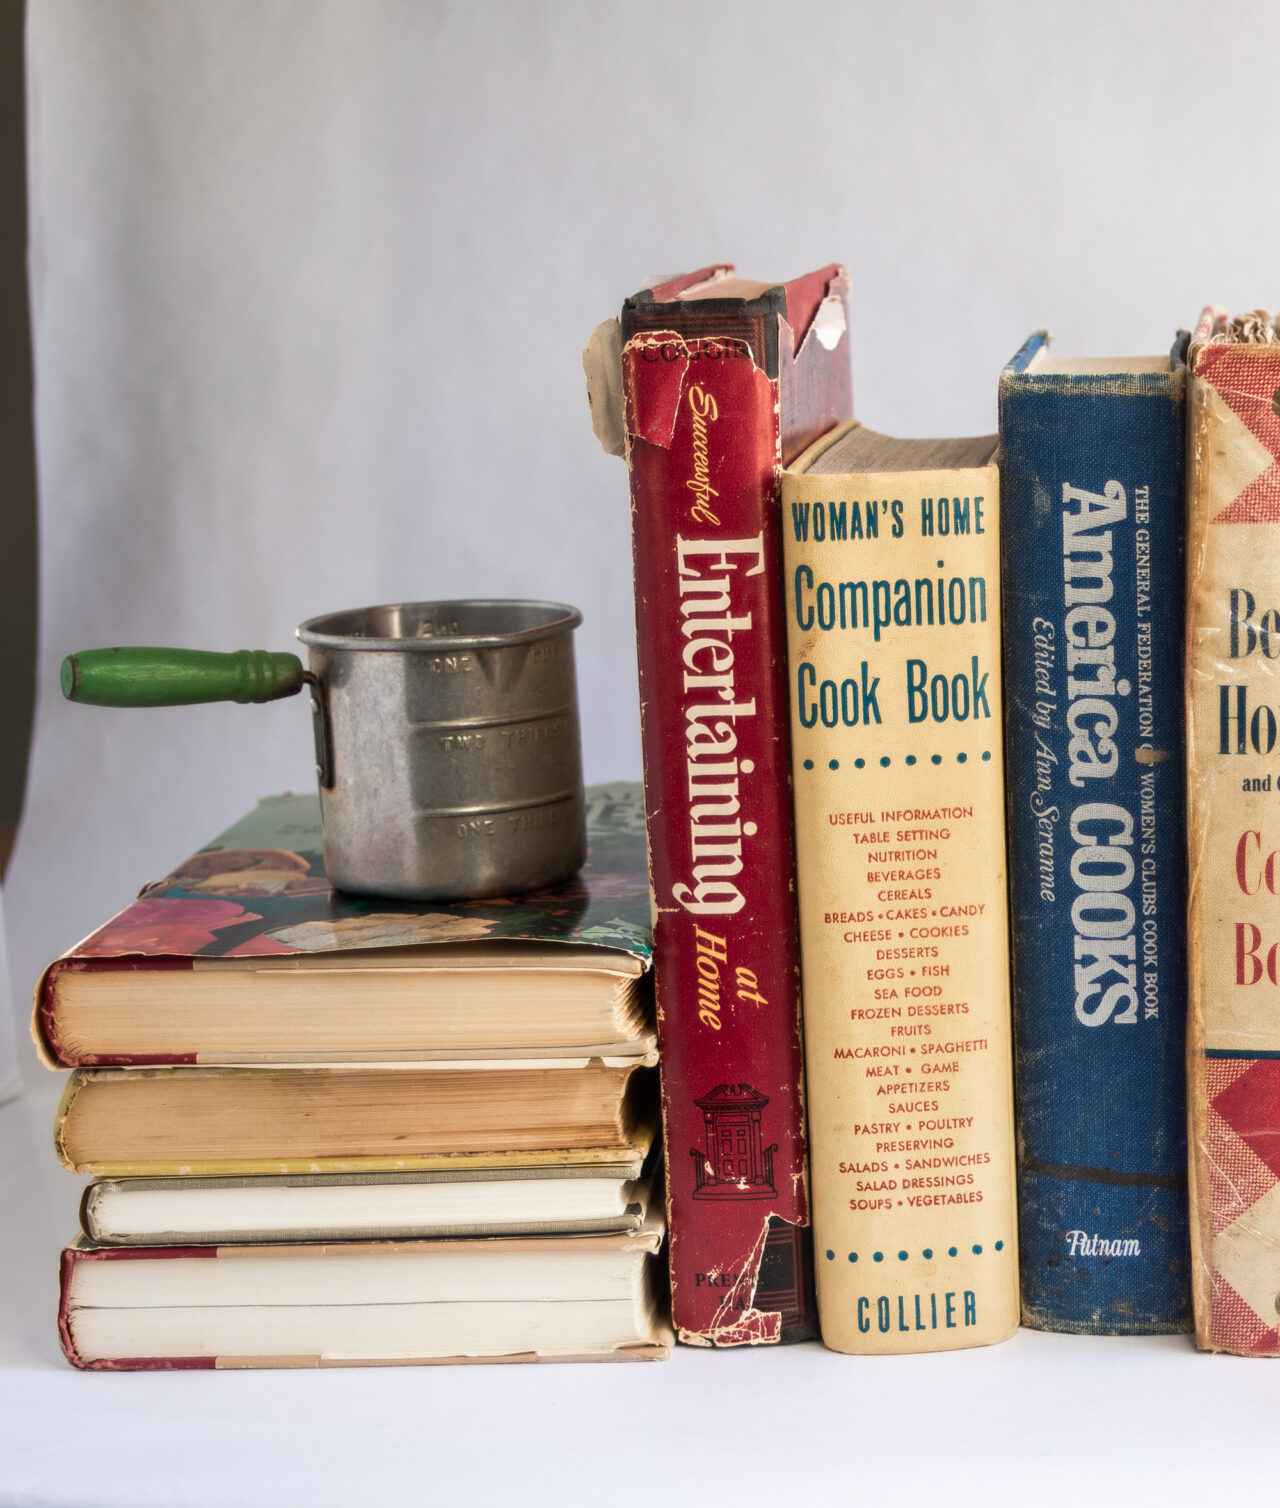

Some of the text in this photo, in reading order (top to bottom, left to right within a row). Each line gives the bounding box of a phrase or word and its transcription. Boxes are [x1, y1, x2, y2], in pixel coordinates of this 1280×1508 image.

[686, 385, 721, 526] Successful
[1134, 485, 1150, 524] THE
[791, 496, 985, 543] WOMAN'S HOME
[1135, 528, 1151, 617] GENERAL
[794, 560, 987, 642] Companion
[430, 655, 473, 673] ONE
[1137, 622, 1153, 737] FEDERATION
[797, 655, 991, 729] Cook Book
[672, 530, 765, 915] Entertaining
[440, 733, 485, 752] TWO
[1062, 479, 1139, 1027] America COOKS
[1030, 616, 1060, 902] Edited by Ann Seranne
[1242, 774, 1272, 792] and
[828, 805, 974, 826] USEFUL INFORMATION
[1140, 772, 1156, 853] WOMEN'S
[457, 820, 496, 838] ONE
[852, 827, 951, 845] TABLE SETTING
[867, 848, 938, 864] NUTRITION
[866, 867, 942, 884] BEVERAGES
[876, 887, 933, 903] CEREALS
[1141, 858, 1157, 916] CLUBS
[823, 903, 986, 923] BREADS CAKES CANDY
[843, 924, 970, 944] CHEESE COOKIES
[1142, 919, 1158, 967] COOK
[876, 945, 939, 961] DESSERTS
[692, 923, 728, 1031] Home
[866, 964, 950, 981] EGGS FISH
[735, 966, 769, 1009] at
[873, 985, 943, 1001] SEA FOOD
[1143, 971, 1159, 1020] BOOK
[850, 1001, 970, 1021] FROZEN DESSERTS
[890, 1023, 932, 1038] FRUITS
[833, 1038, 988, 1060] MACARONI SPAGHETTI
[865, 1061, 960, 1078] MEAT GAME
[876, 1079, 951, 1096] APPETIZERS
[888, 1099, 940, 1115] SAUCES
[853, 1116, 974, 1136] PASTRY POULTRY
[875, 1137, 955, 1154] PRESERVING
[838, 1151, 991, 1174] SALADS SANDWICHES
[855, 1173, 975, 1193] SALAD DRESSINGS
[848, 1190, 984, 1211] SOUPS VEGETABLES
[1065, 1230, 1141, 1257] Putnam
[857, 1290, 976, 1334] COLLIER
